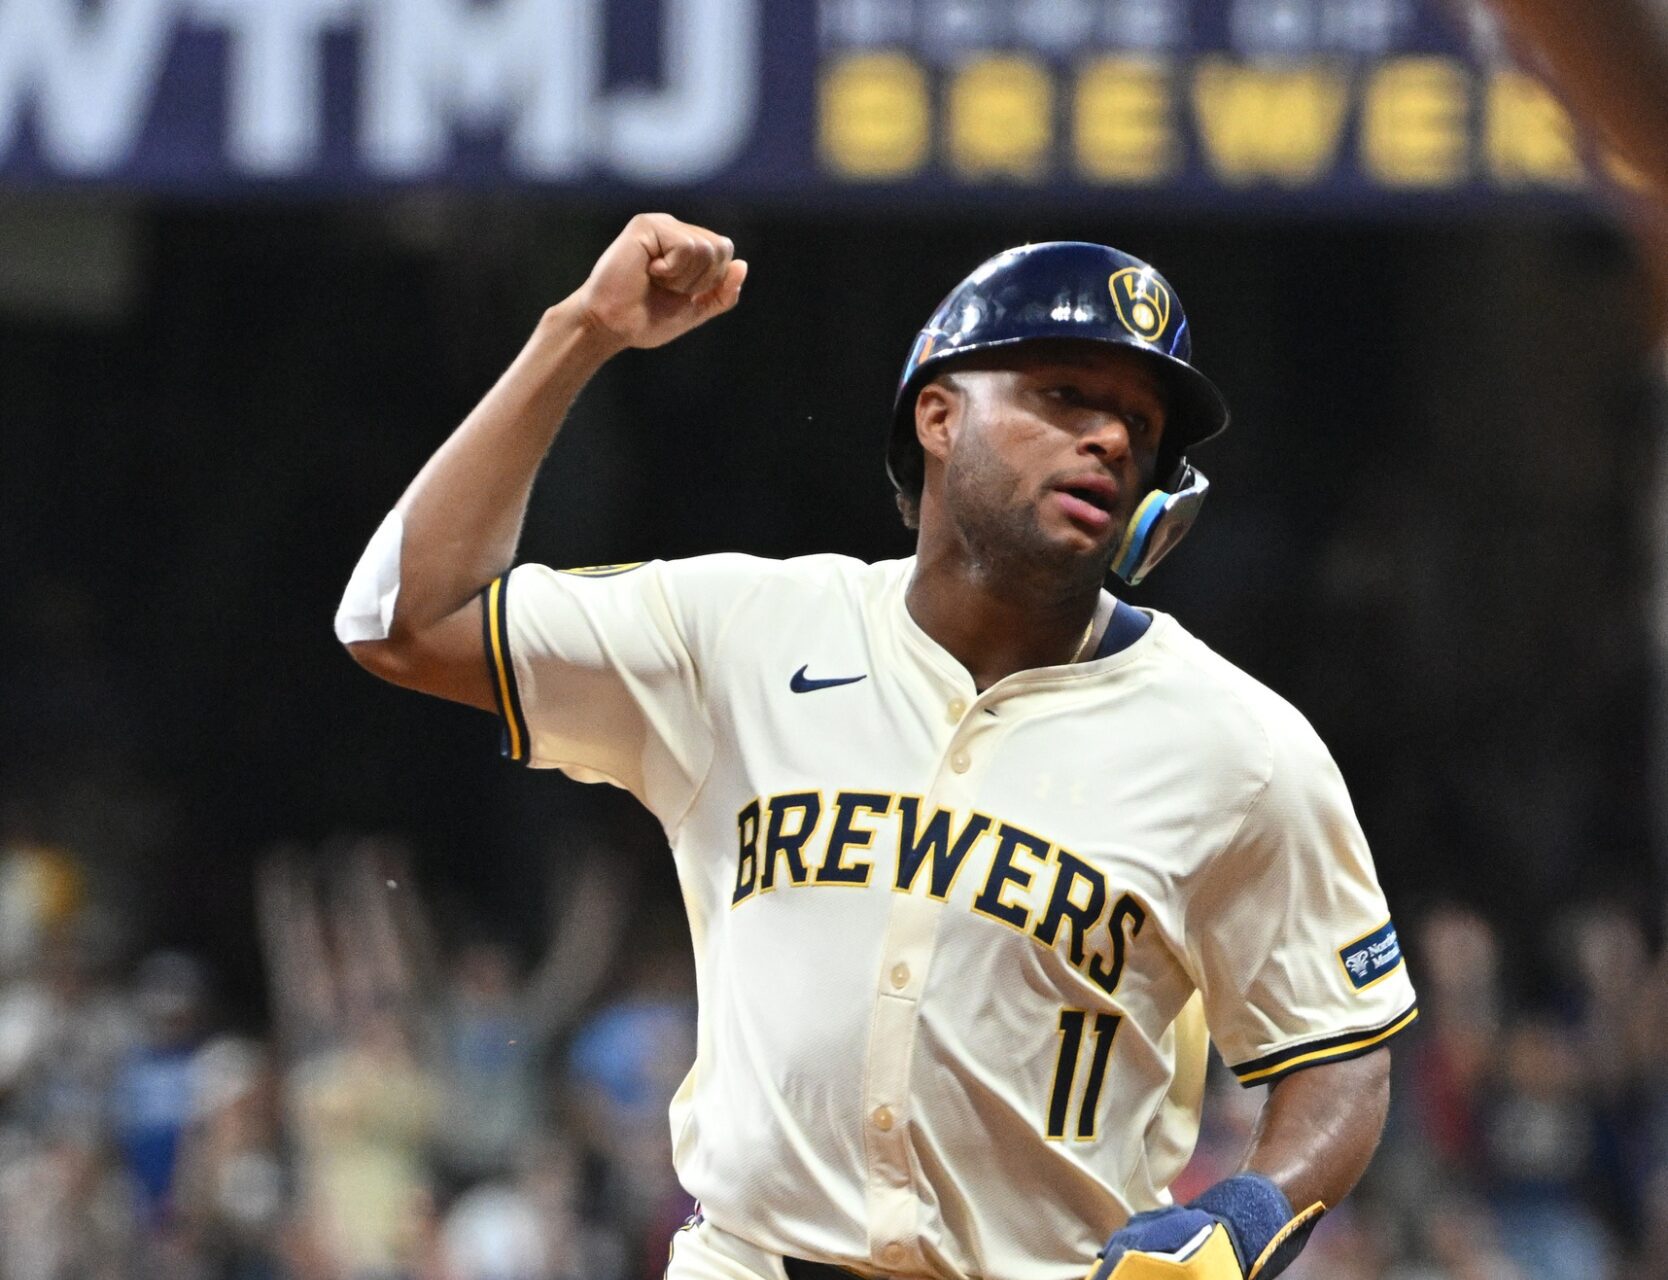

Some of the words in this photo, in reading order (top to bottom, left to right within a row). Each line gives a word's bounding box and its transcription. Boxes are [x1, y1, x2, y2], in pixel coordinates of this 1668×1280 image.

[818, 50, 1642, 190] BREWER
[731, 788, 1146, 998] BREWERS
[1044, 1005, 1124, 1142] 11
